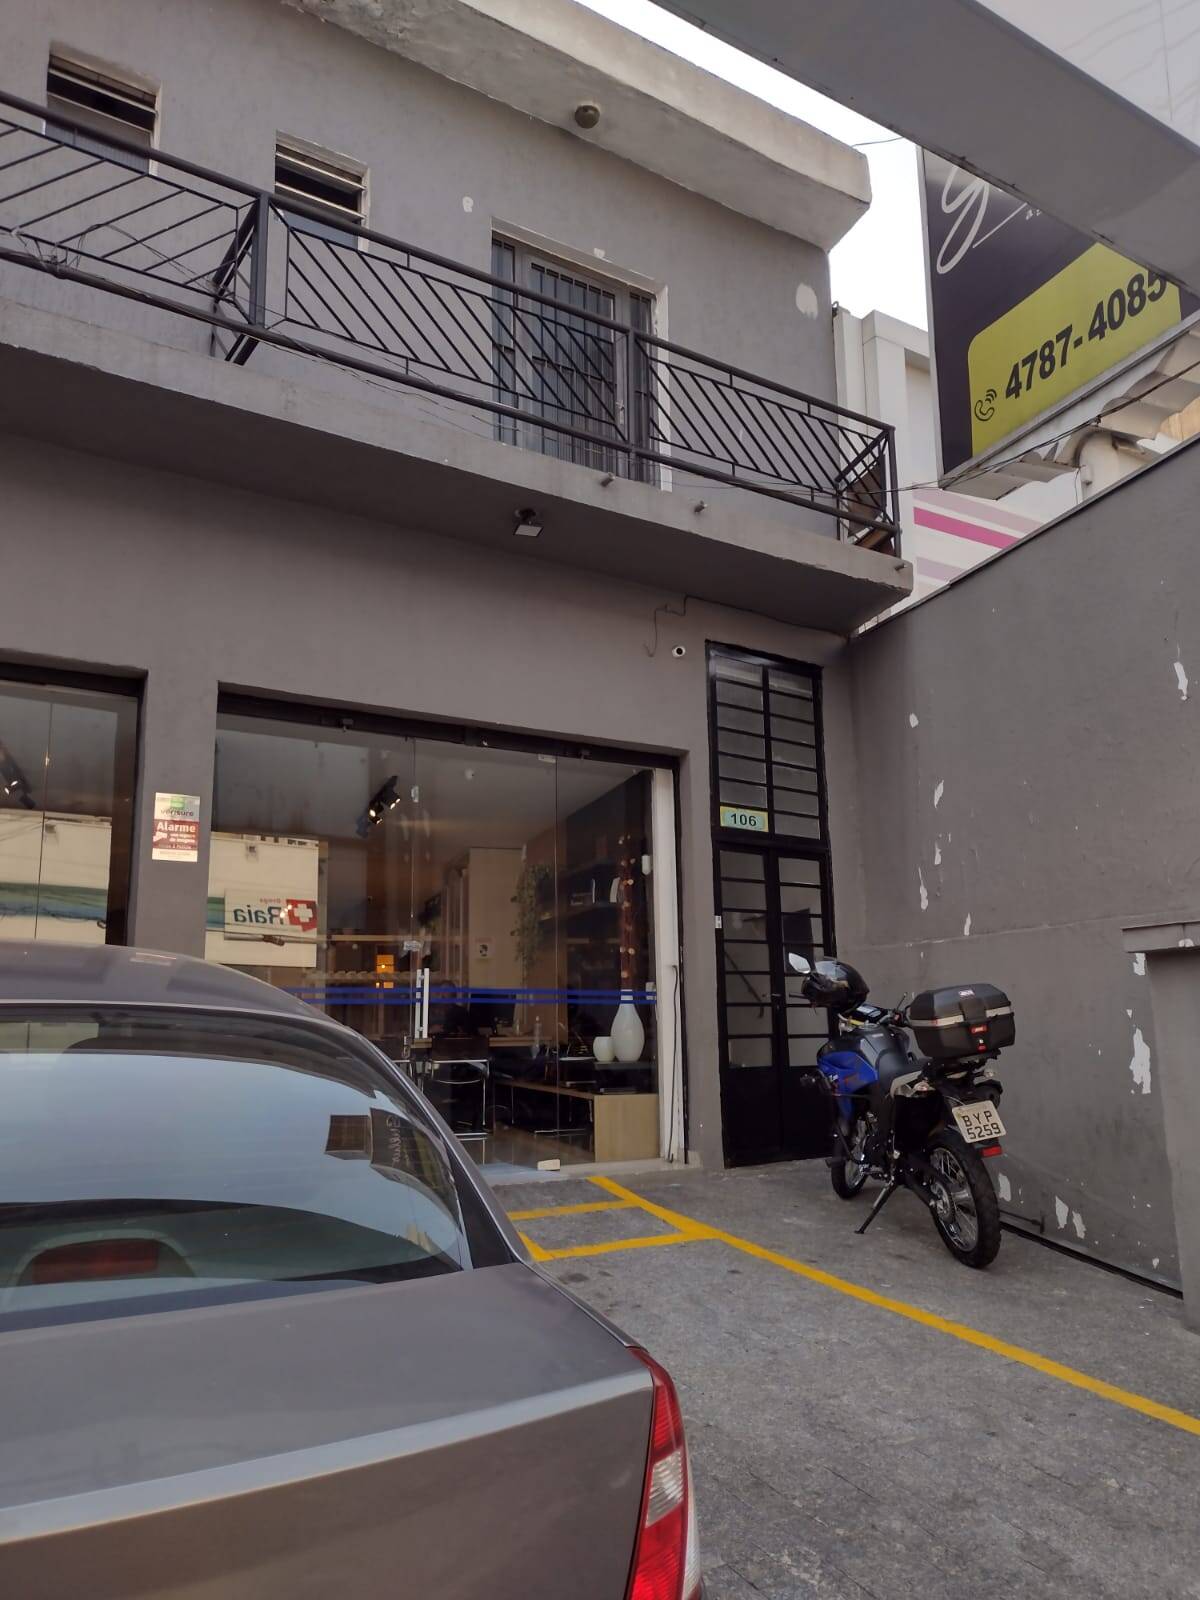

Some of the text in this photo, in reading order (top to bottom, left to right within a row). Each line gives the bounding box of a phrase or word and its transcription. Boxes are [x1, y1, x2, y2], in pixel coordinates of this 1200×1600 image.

[156, 821, 196, 833] Alarme
[730, 813, 758, 827] 106
[961, 1110, 993, 1127] BYP
[966, 1122, 1002, 1140] 5259
